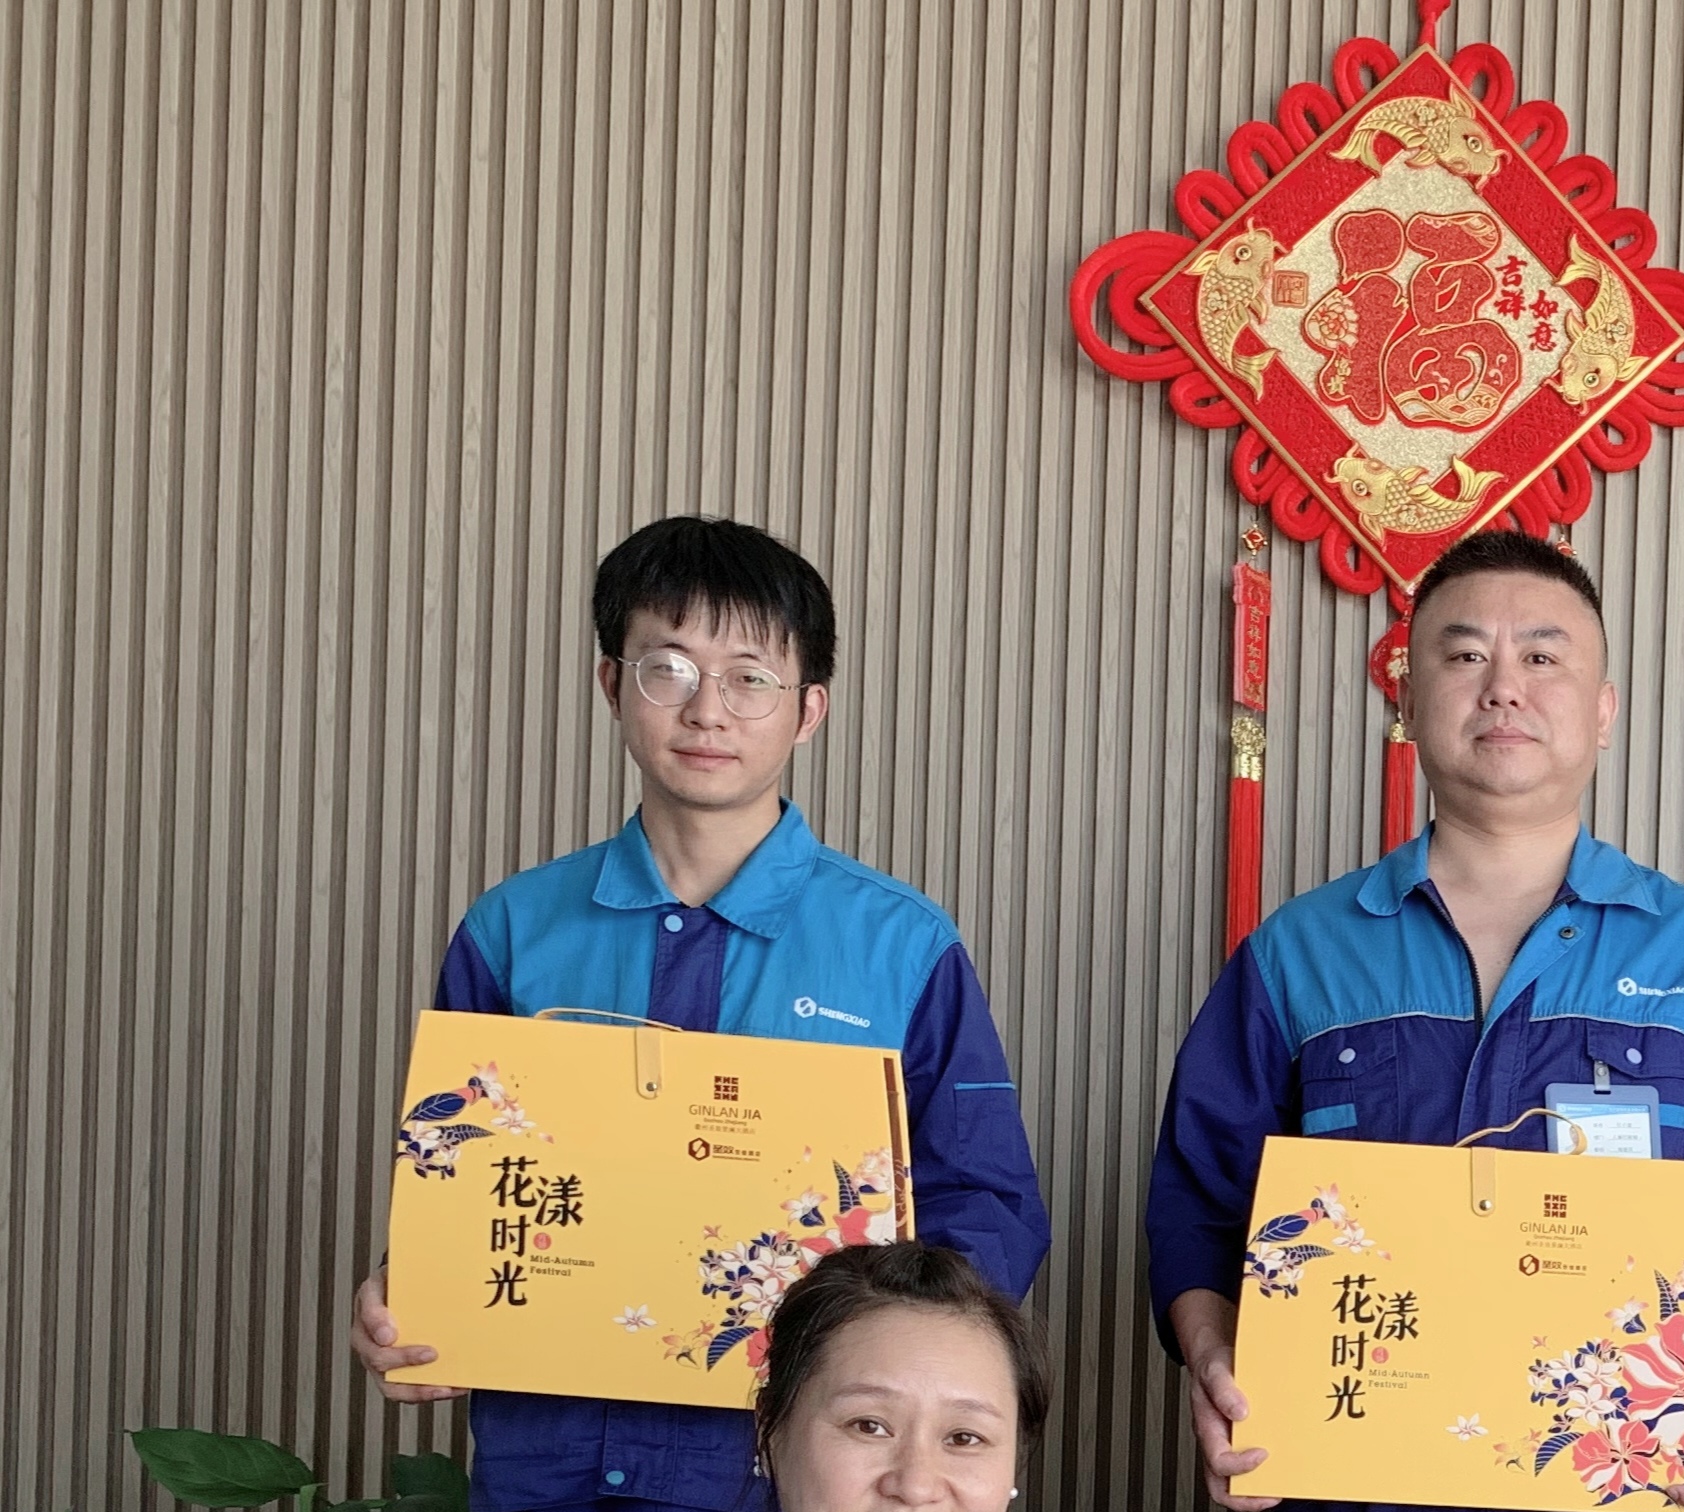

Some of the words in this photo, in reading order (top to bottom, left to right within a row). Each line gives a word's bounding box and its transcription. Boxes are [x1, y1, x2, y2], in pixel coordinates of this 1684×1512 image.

[1494, 255, 1527, 320] 吉祥
[1302, 208, 1522, 431] 福
[1528, 290, 1558, 352] 如意
[689, 1104, 738, 1118] GINLAN
[742, 1109, 762, 1120] JIA
[1520, 1222, 1566, 1234] GINLAN
[1570, 1225, 1588, 1236] JIA
[530, 1255, 595, 1267] Mid-Autumn
[530, 1266, 571, 1276] Festival
[1369, 1369, 1430, 1379] Mid-Autumn
[1368, 1380, 1407, 1389] Festival
